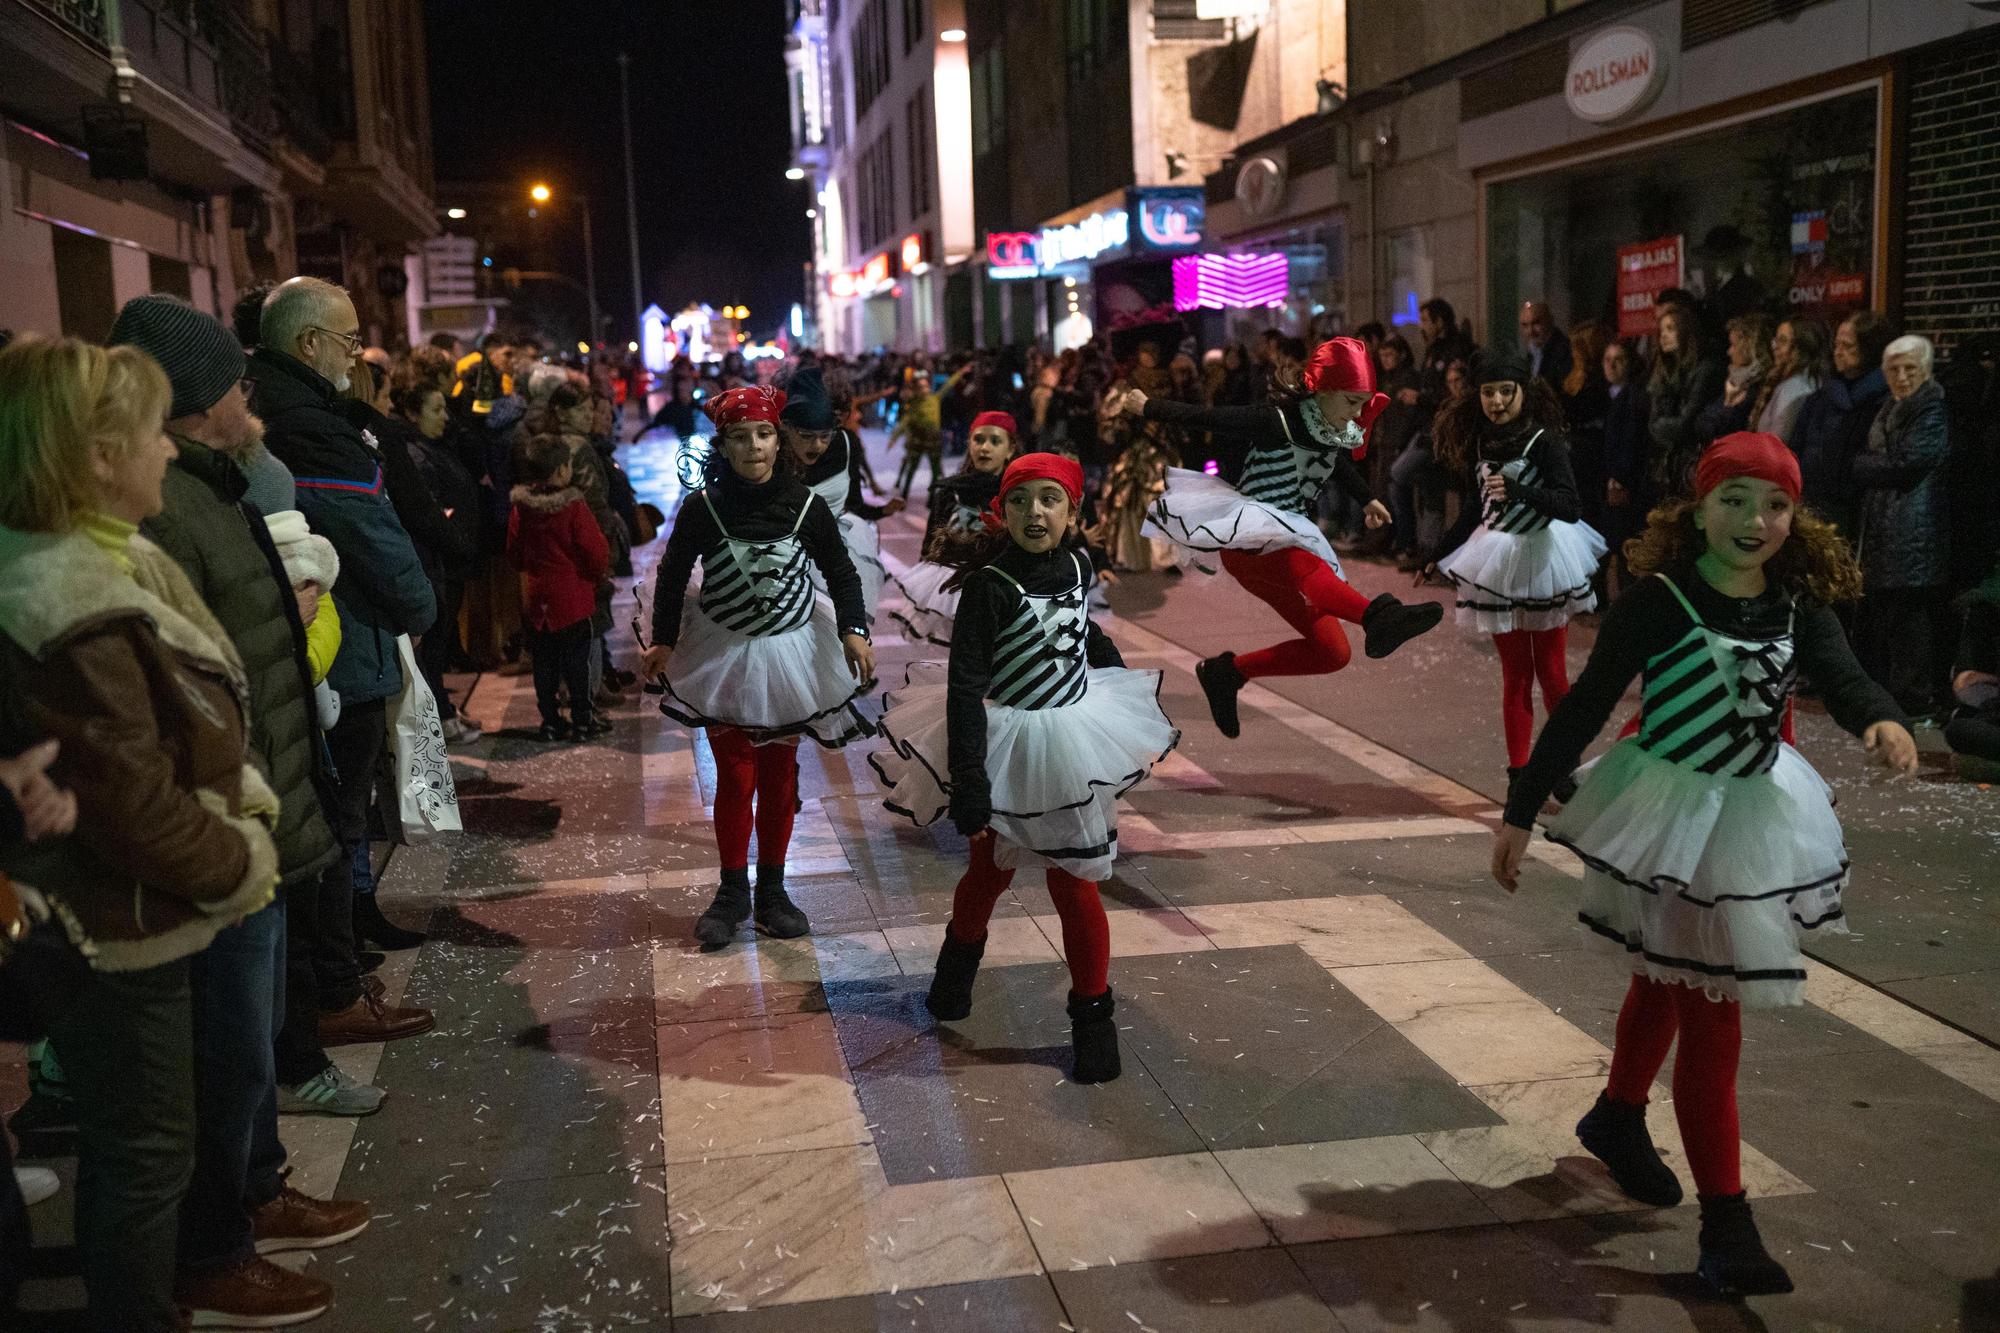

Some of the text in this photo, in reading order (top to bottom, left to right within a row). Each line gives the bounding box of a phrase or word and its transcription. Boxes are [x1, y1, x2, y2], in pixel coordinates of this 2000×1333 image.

[1573, 54, 1649, 96] ROLLSMAN
[1621, 246, 1677, 273] REBAJAS
[1622, 292, 1655, 312] REBA
[1789, 285, 1826, 304] ONLY
